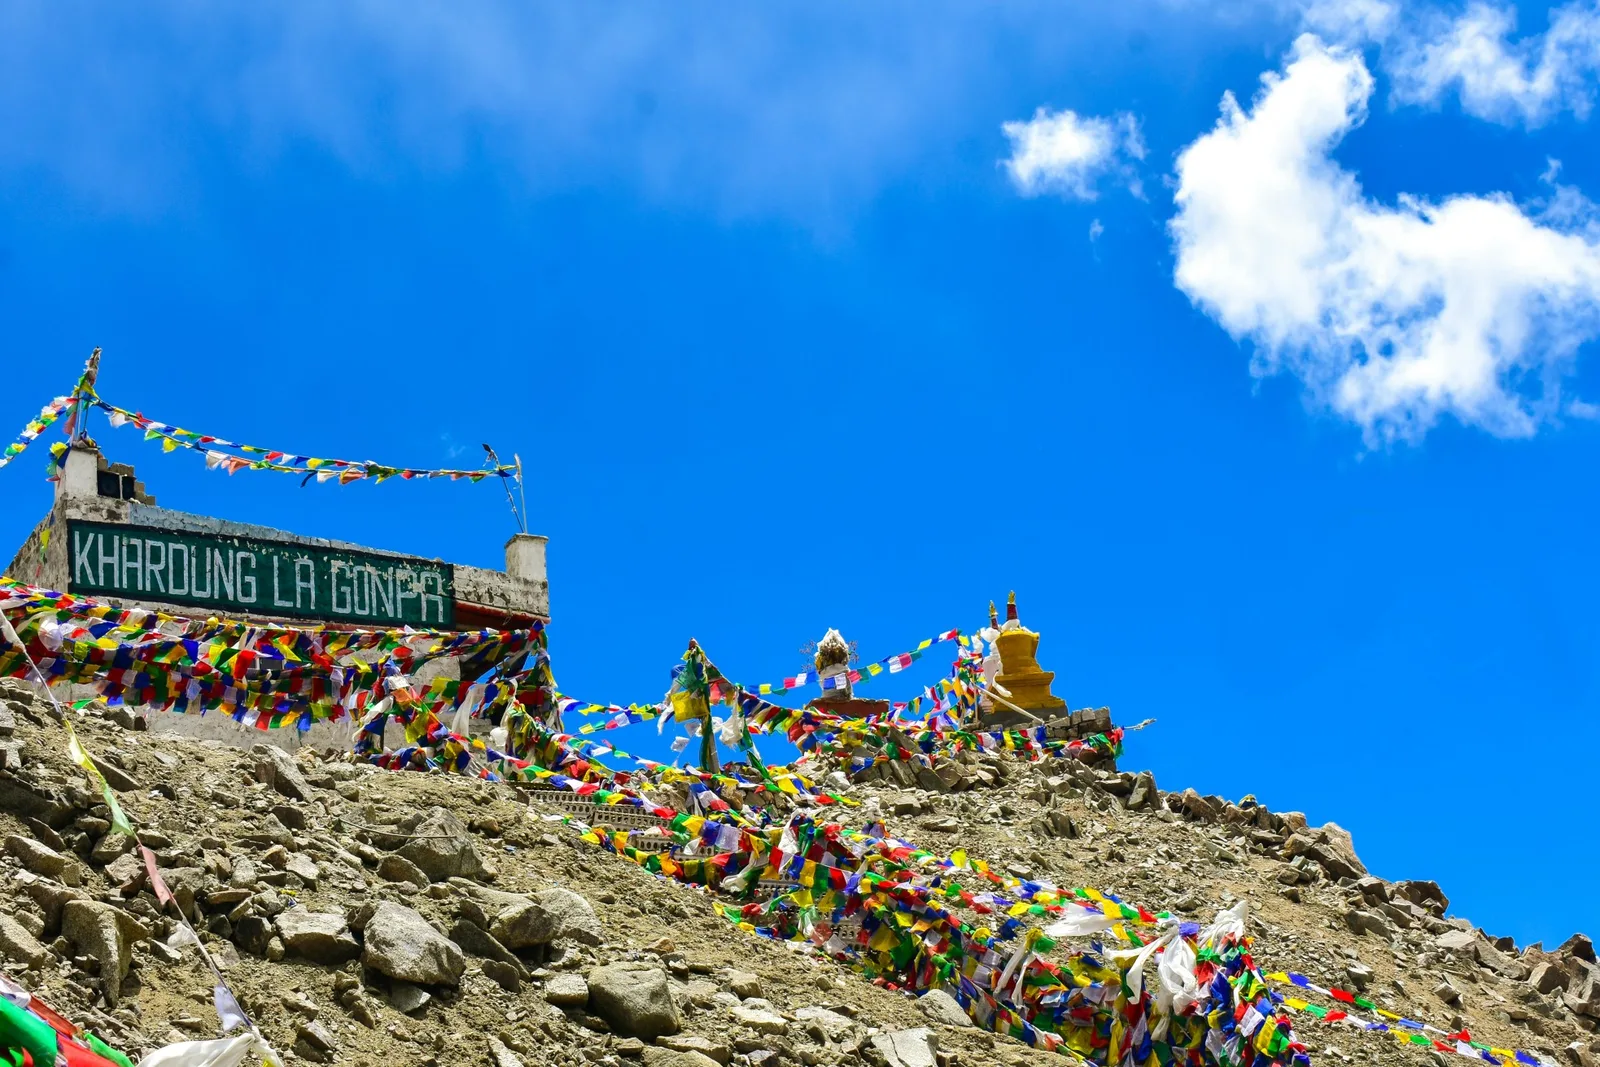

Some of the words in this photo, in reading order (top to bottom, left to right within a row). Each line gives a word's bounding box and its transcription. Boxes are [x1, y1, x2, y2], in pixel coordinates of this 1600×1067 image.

[74, 531, 257, 603] KHARDUNG
[273, 555, 316, 610] LA
[330, 561, 444, 623] GONPA
